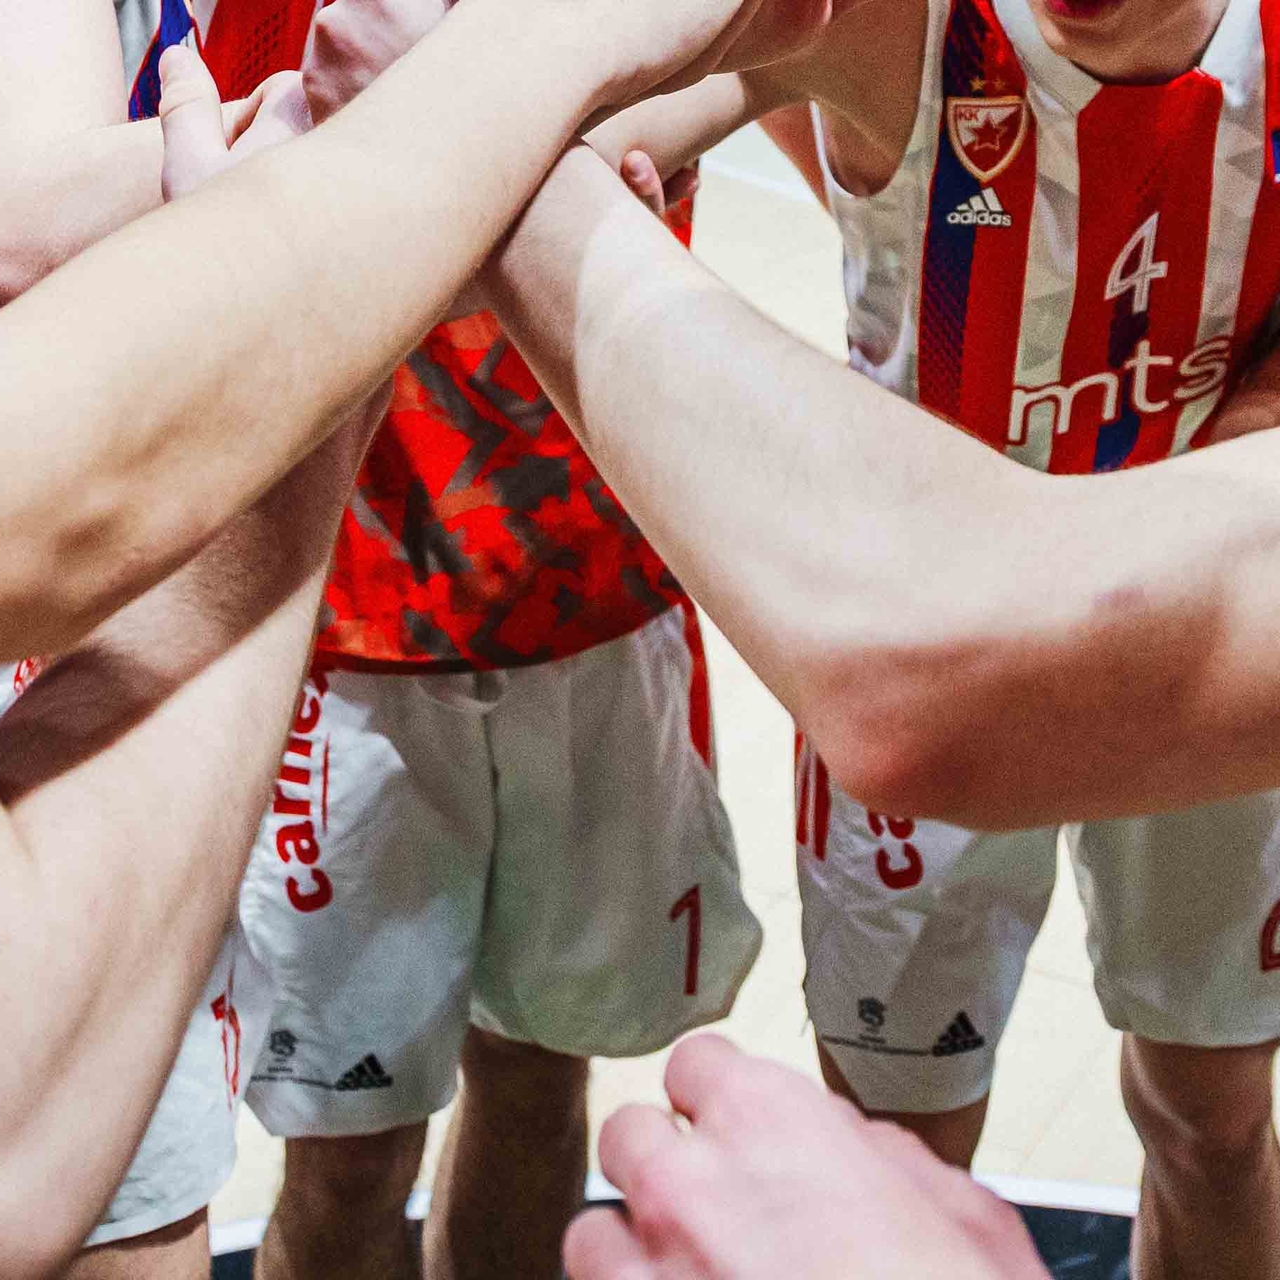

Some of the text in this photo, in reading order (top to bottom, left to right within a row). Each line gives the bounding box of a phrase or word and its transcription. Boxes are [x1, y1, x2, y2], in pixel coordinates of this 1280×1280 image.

[946, 210, 1012, 227] adidas
[1104, 211, 1168, 314] 4
[1007, 336, 1230, 442] mts
[669, 883, 701, 996] 1
